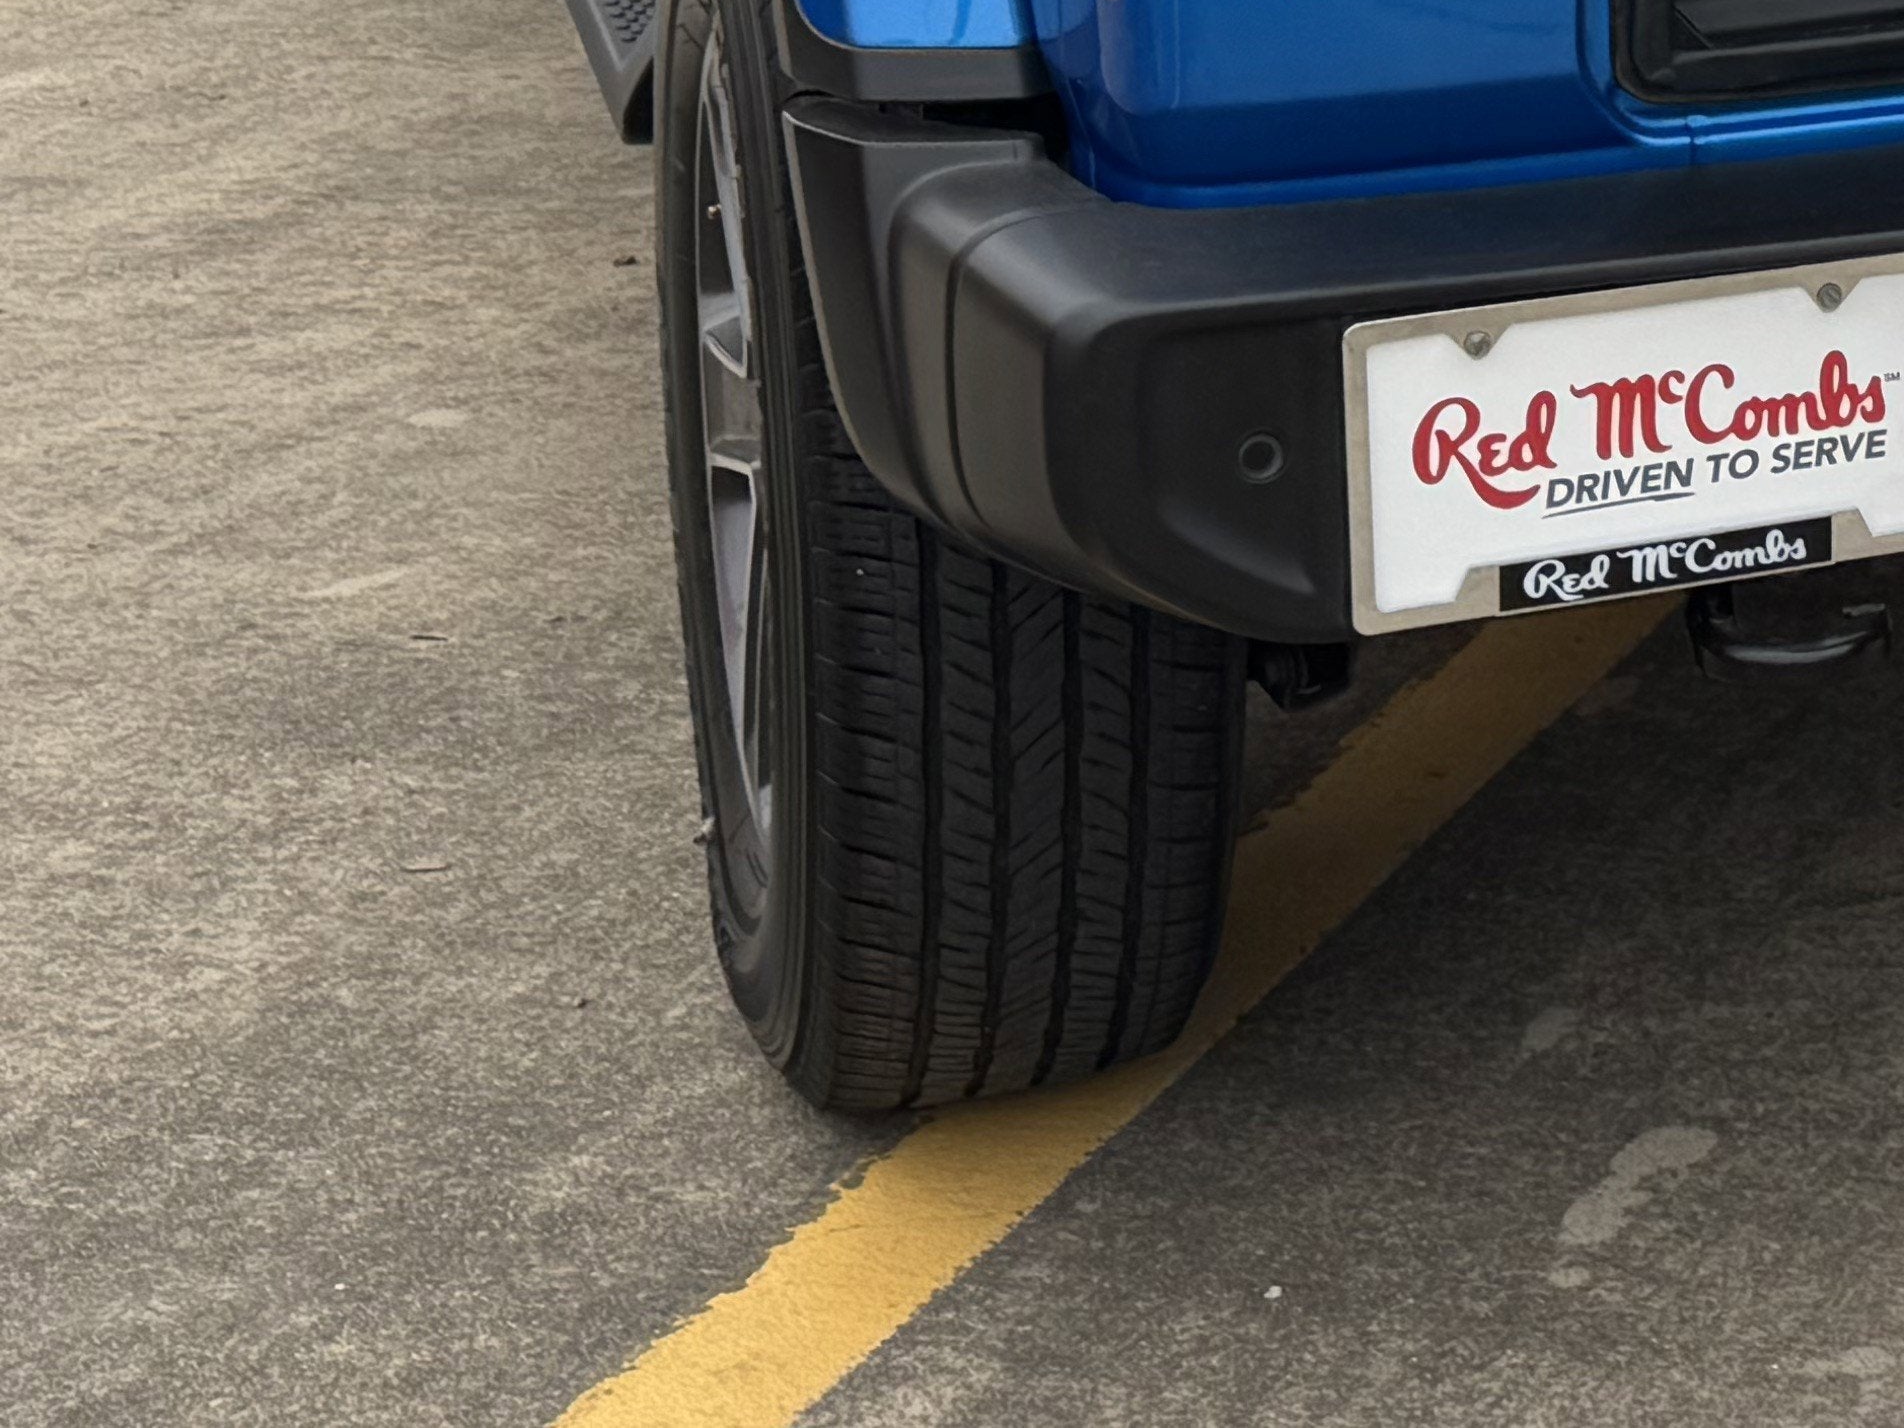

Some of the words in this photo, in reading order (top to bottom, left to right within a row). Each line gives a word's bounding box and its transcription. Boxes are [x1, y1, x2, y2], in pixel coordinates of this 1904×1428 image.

[1412, 390, 1557, 510] Red
[1569, 349, 1886, 458] McCombs
[1546, 458, 1694, 510] DRIVEN
[1706, 448, 1760, 483] TO
[1770, 429, 1888, 474] SERVE
[1522, 559, 1610, 602] Red
[1617, 528, 1807, 584] McCombs
